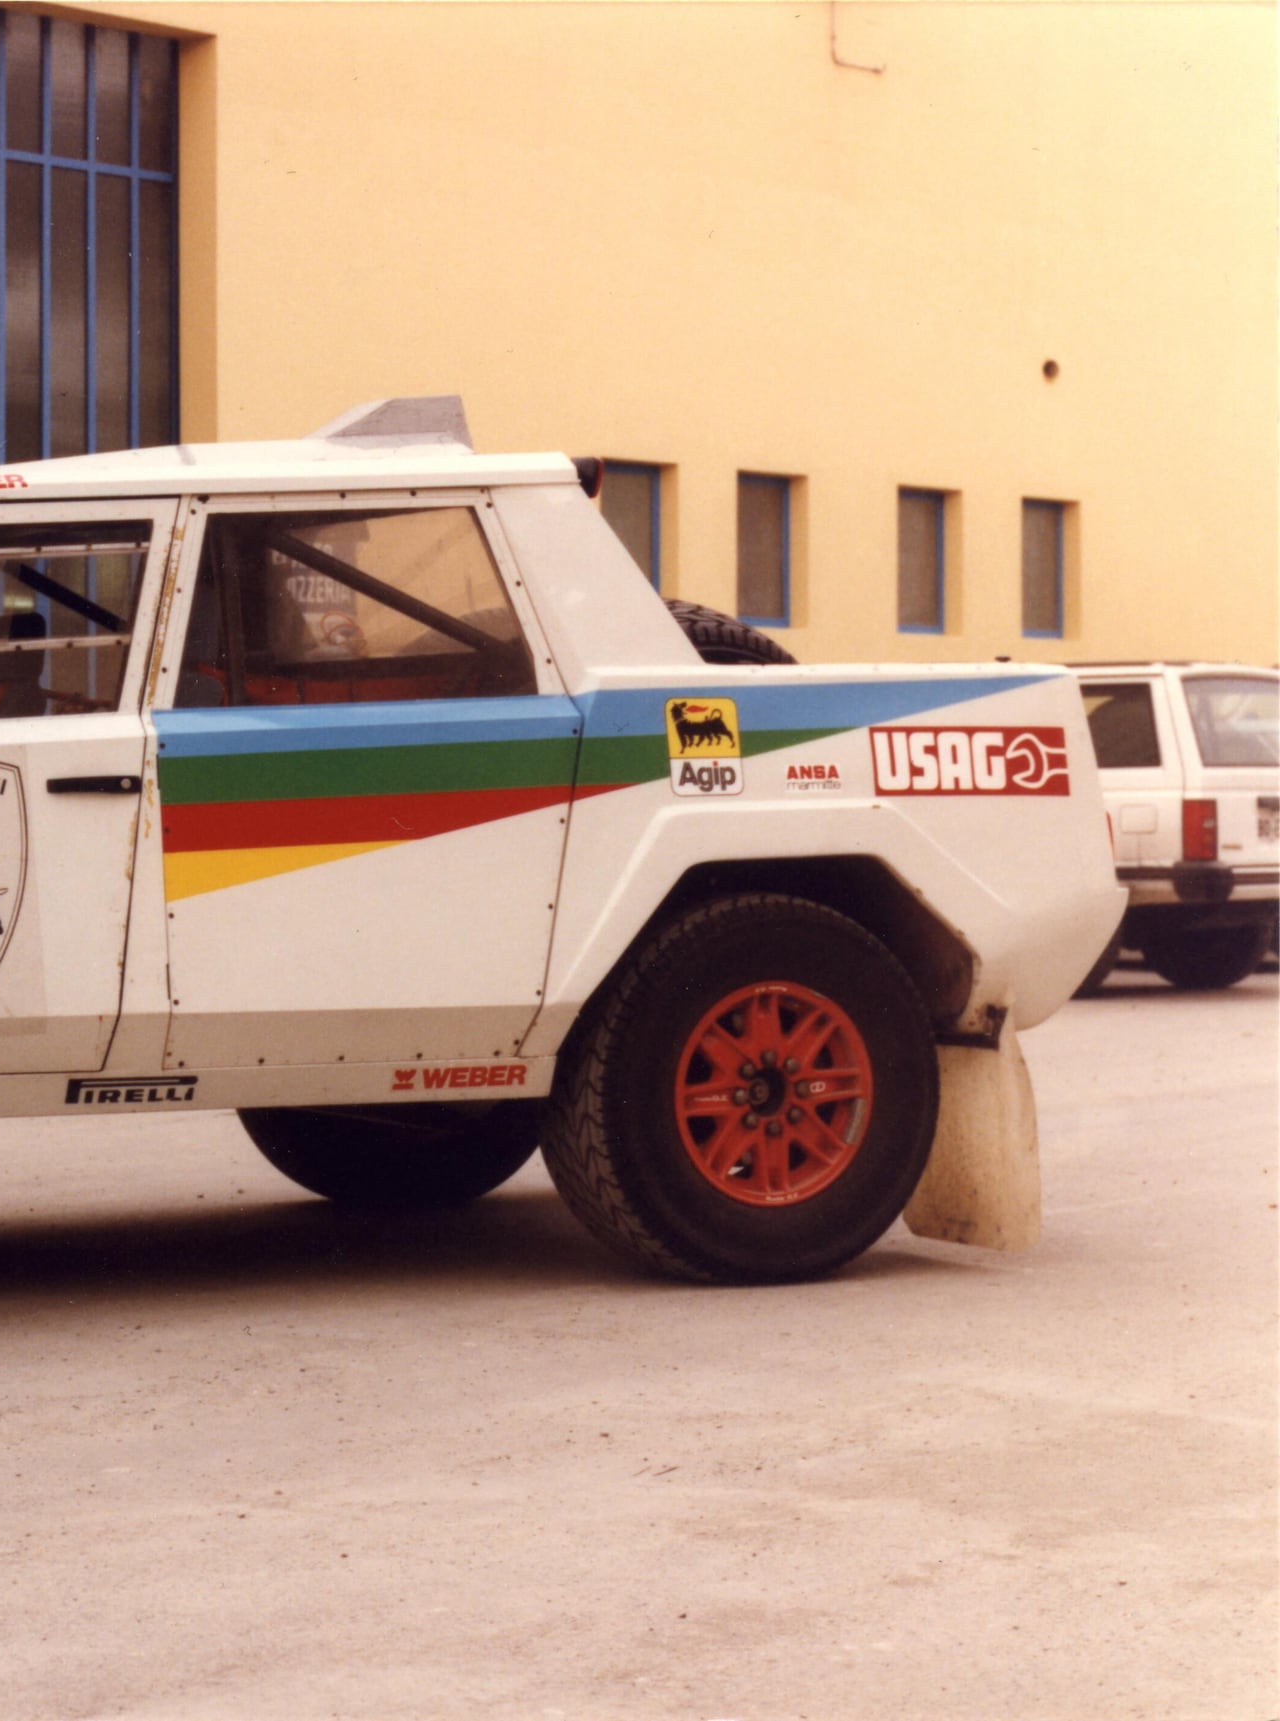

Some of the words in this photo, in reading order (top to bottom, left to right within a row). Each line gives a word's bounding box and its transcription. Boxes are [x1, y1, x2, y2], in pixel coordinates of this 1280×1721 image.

[786, 765, 839, 780] ANSA
[872, 731, 1007, 791] USAG
[678, 761, 736, 792] Agip
[65, 1076, 198, 1104] PIRELLI
[423, 1065, 527, 1089] WEBER
